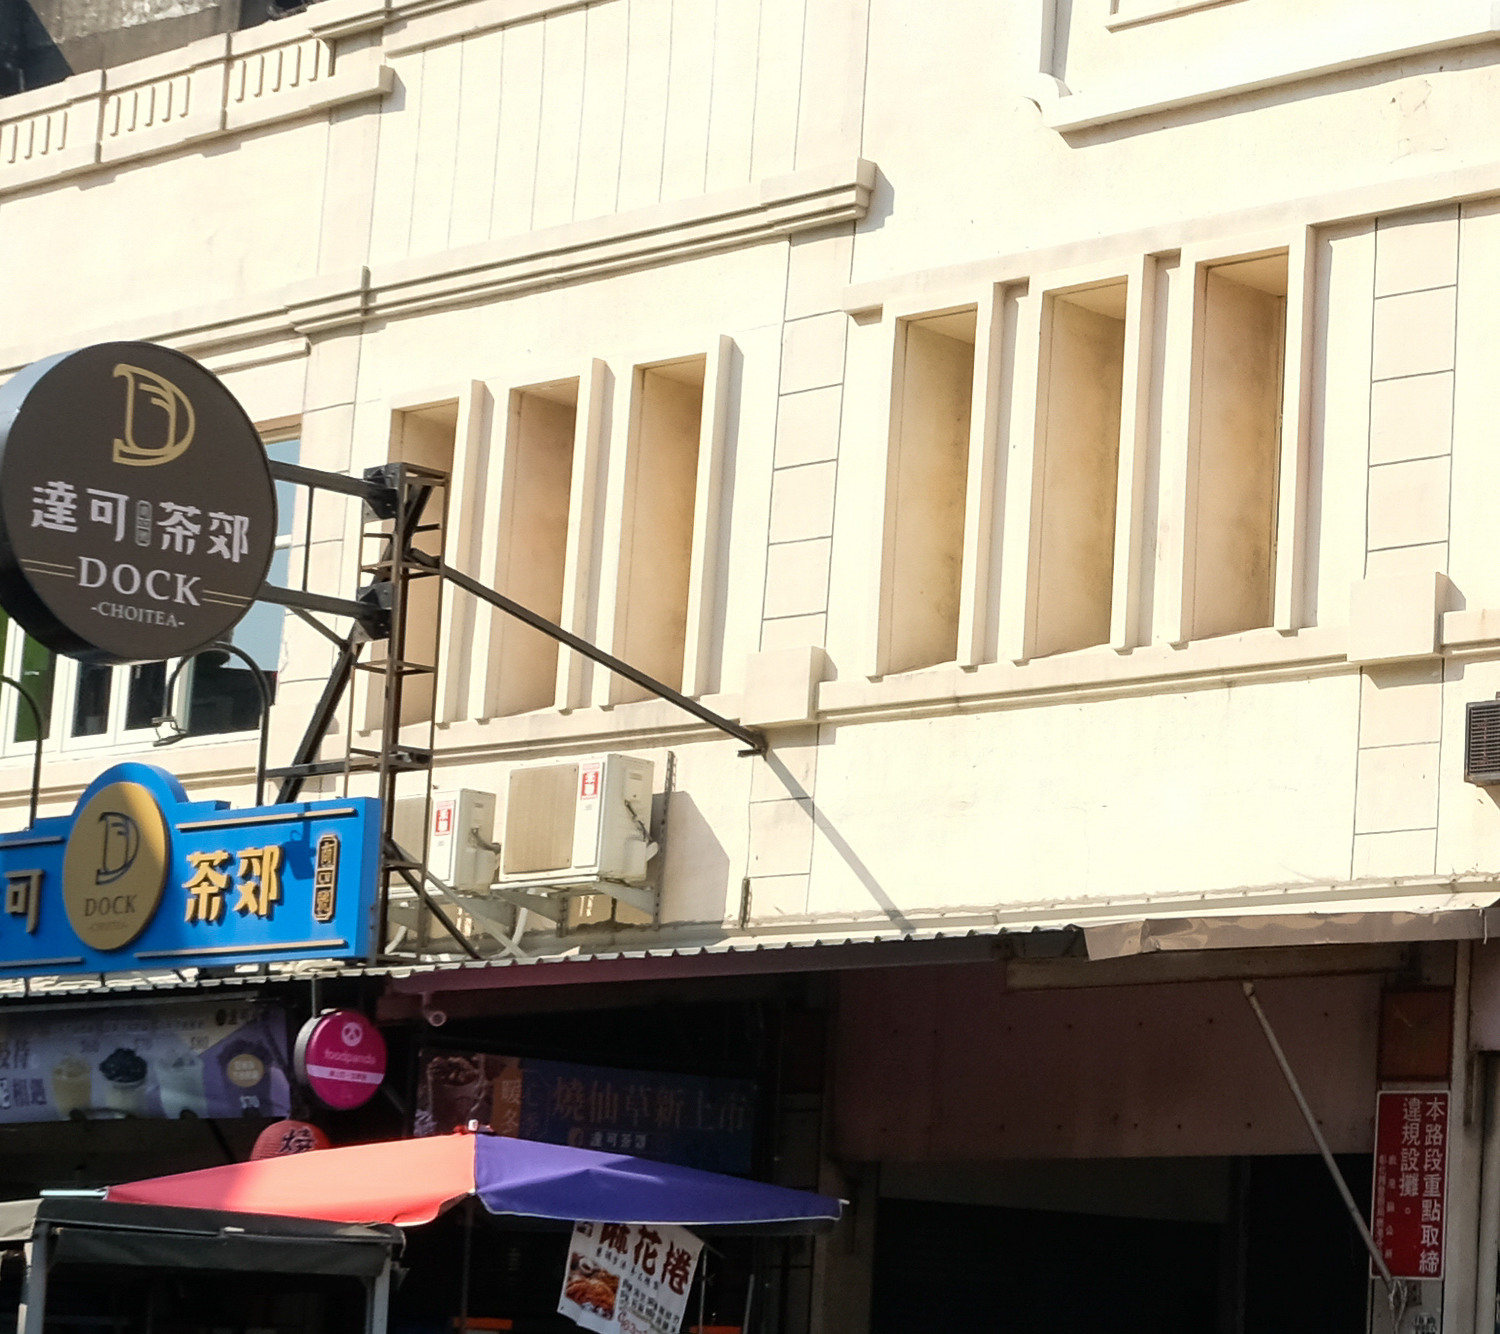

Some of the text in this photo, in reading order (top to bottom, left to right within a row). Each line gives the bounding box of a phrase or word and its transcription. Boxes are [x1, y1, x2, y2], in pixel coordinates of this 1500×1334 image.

[78, 556, 202, 607] DOCK
[83, 893, 139, 917] DOCK
[182, 844, 283, 923] 茶郊
[1418, 1097, 1446, 1275] 本路段重點取締
